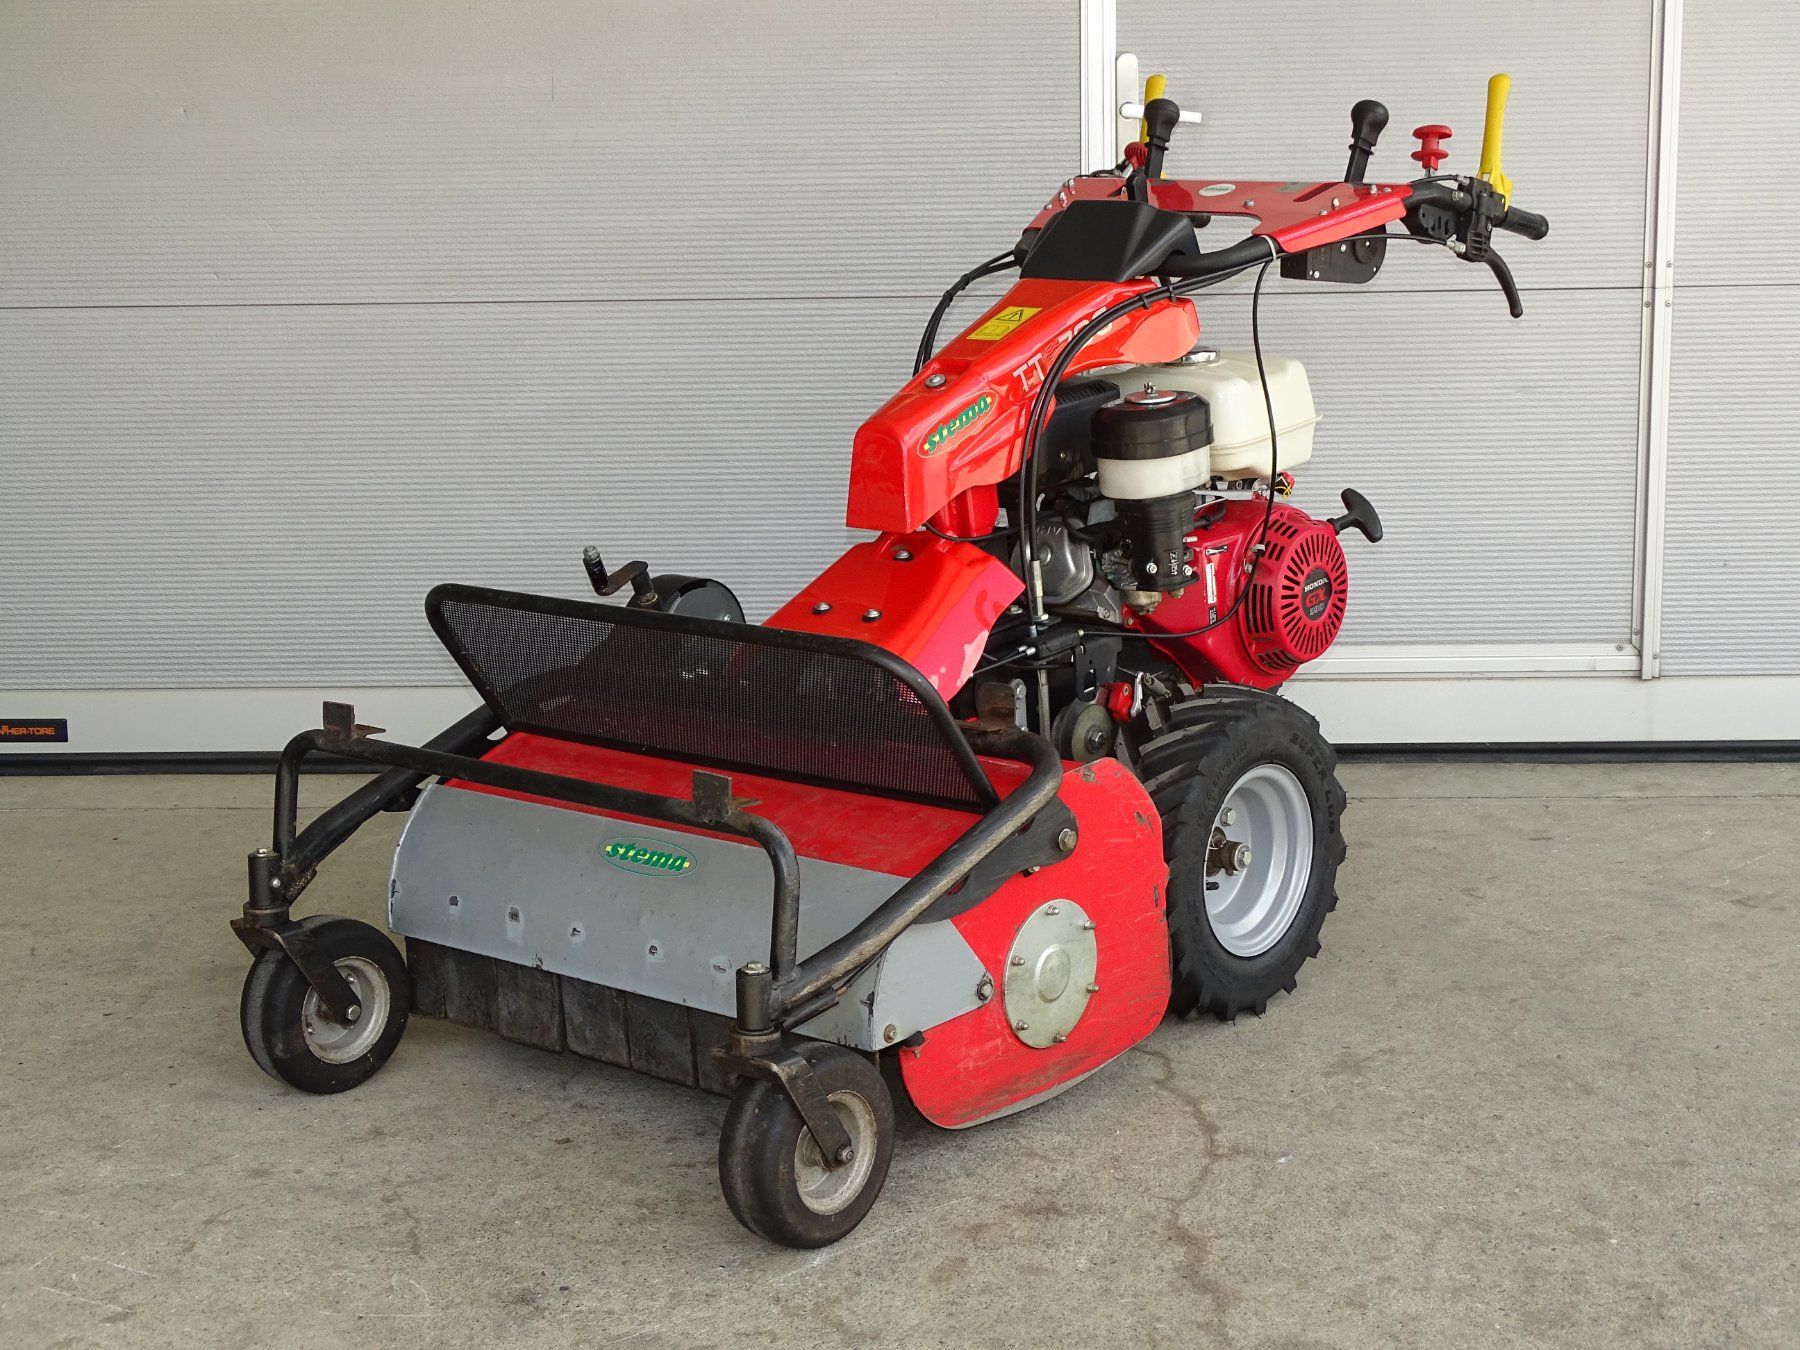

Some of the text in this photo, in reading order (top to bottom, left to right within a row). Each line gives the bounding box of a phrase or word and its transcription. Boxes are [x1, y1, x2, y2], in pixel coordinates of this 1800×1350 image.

[924, 395, 991, 452] stema
[1304, 577, 1328, 593] HONDA
[1305, 588, 1326, 607] GX
[605, 842, 689, 872] stema
